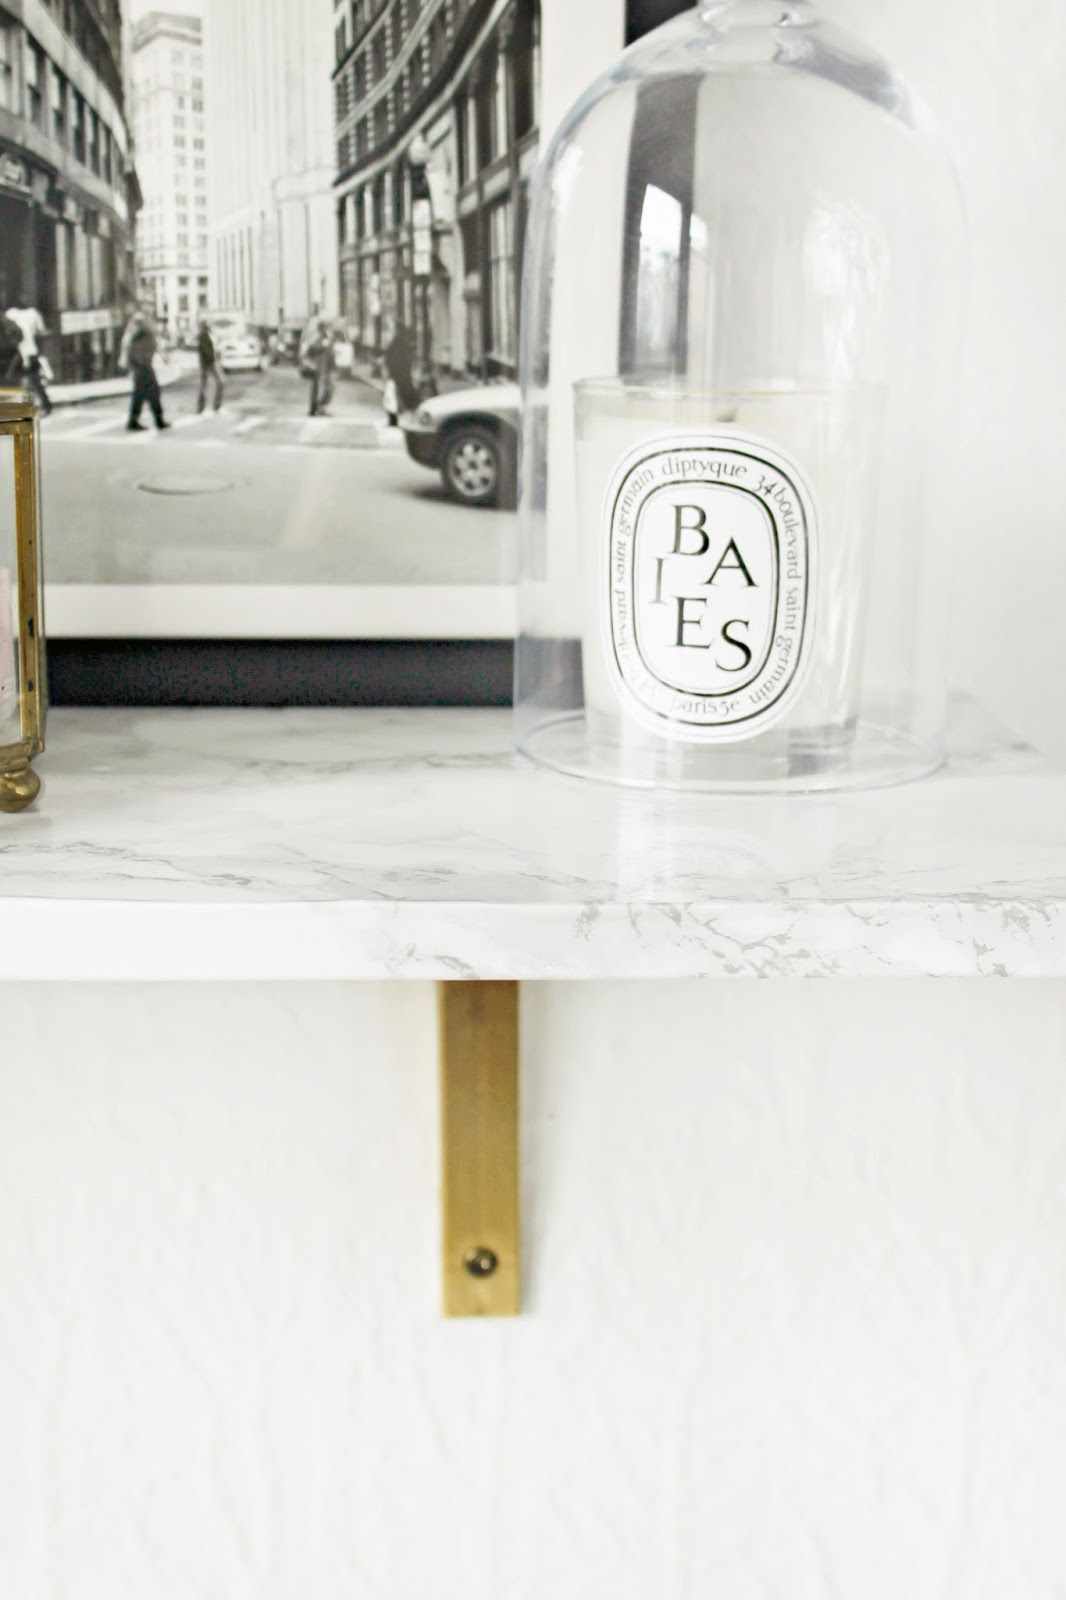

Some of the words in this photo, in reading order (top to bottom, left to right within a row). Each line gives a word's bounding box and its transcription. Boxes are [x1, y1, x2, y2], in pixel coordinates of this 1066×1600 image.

[661, 457, 748, 479] diptyque
[618, 467, 655, 537] germain
[615, 540, 628, 583] saint
[785, 586, 801, 631] saint
[749, 634, 794, 705] germain
